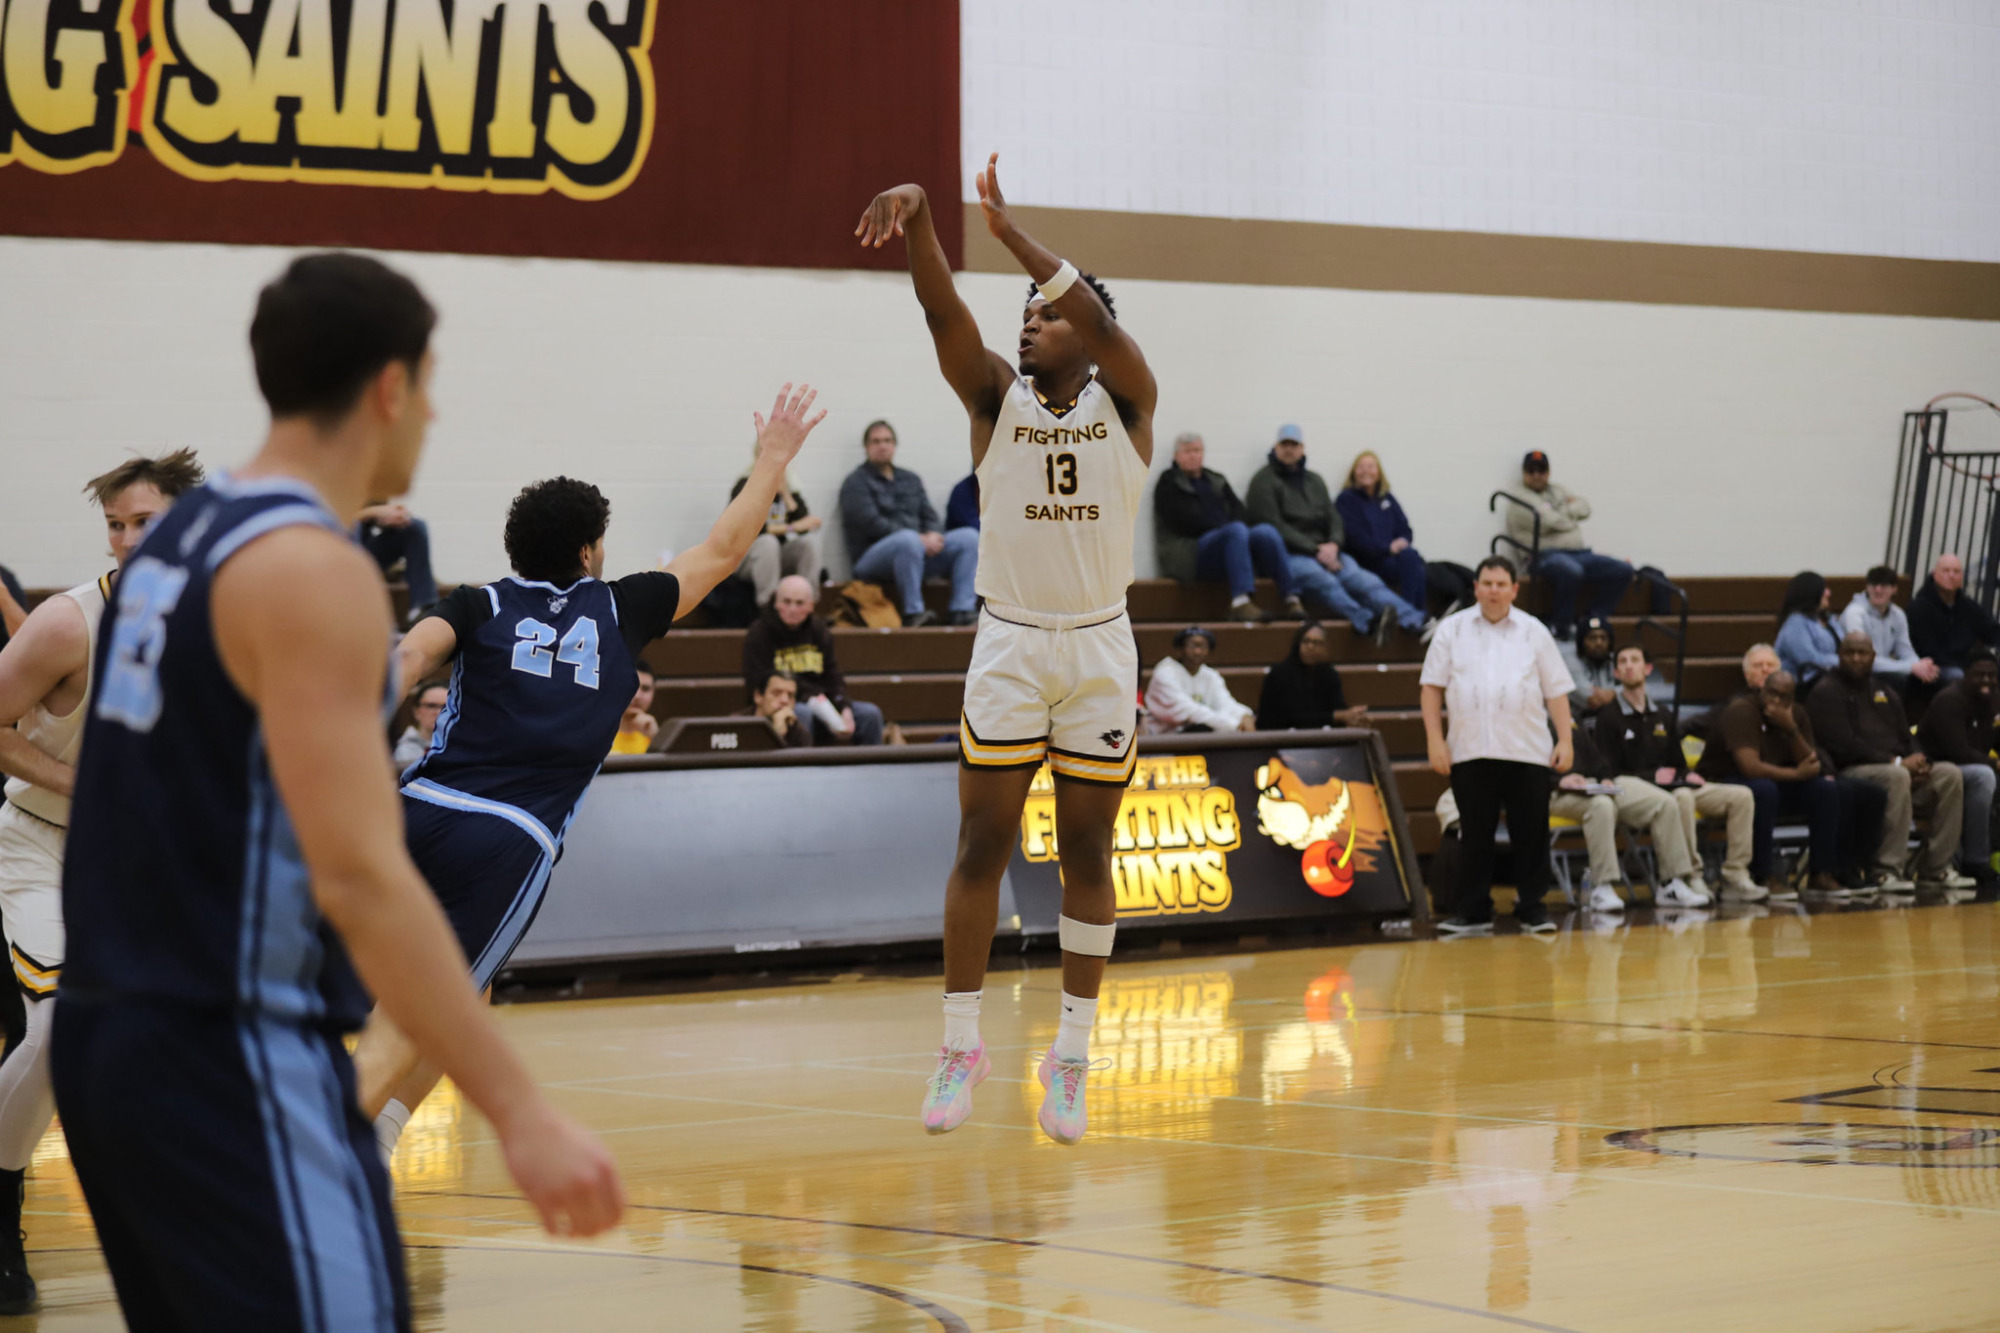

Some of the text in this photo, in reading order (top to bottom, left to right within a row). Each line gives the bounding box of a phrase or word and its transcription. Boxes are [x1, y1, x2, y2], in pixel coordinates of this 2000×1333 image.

[0, 0, 630, 166] G SAINTS
[1013, 422, 1108, 446] FIGHTING
[1045, 452, 1078, 496] 13
[511, 615, 601, 690] 24
[1153, 757, 1208, 785] THE
[1024, 790, 1237, 856] FHTING
